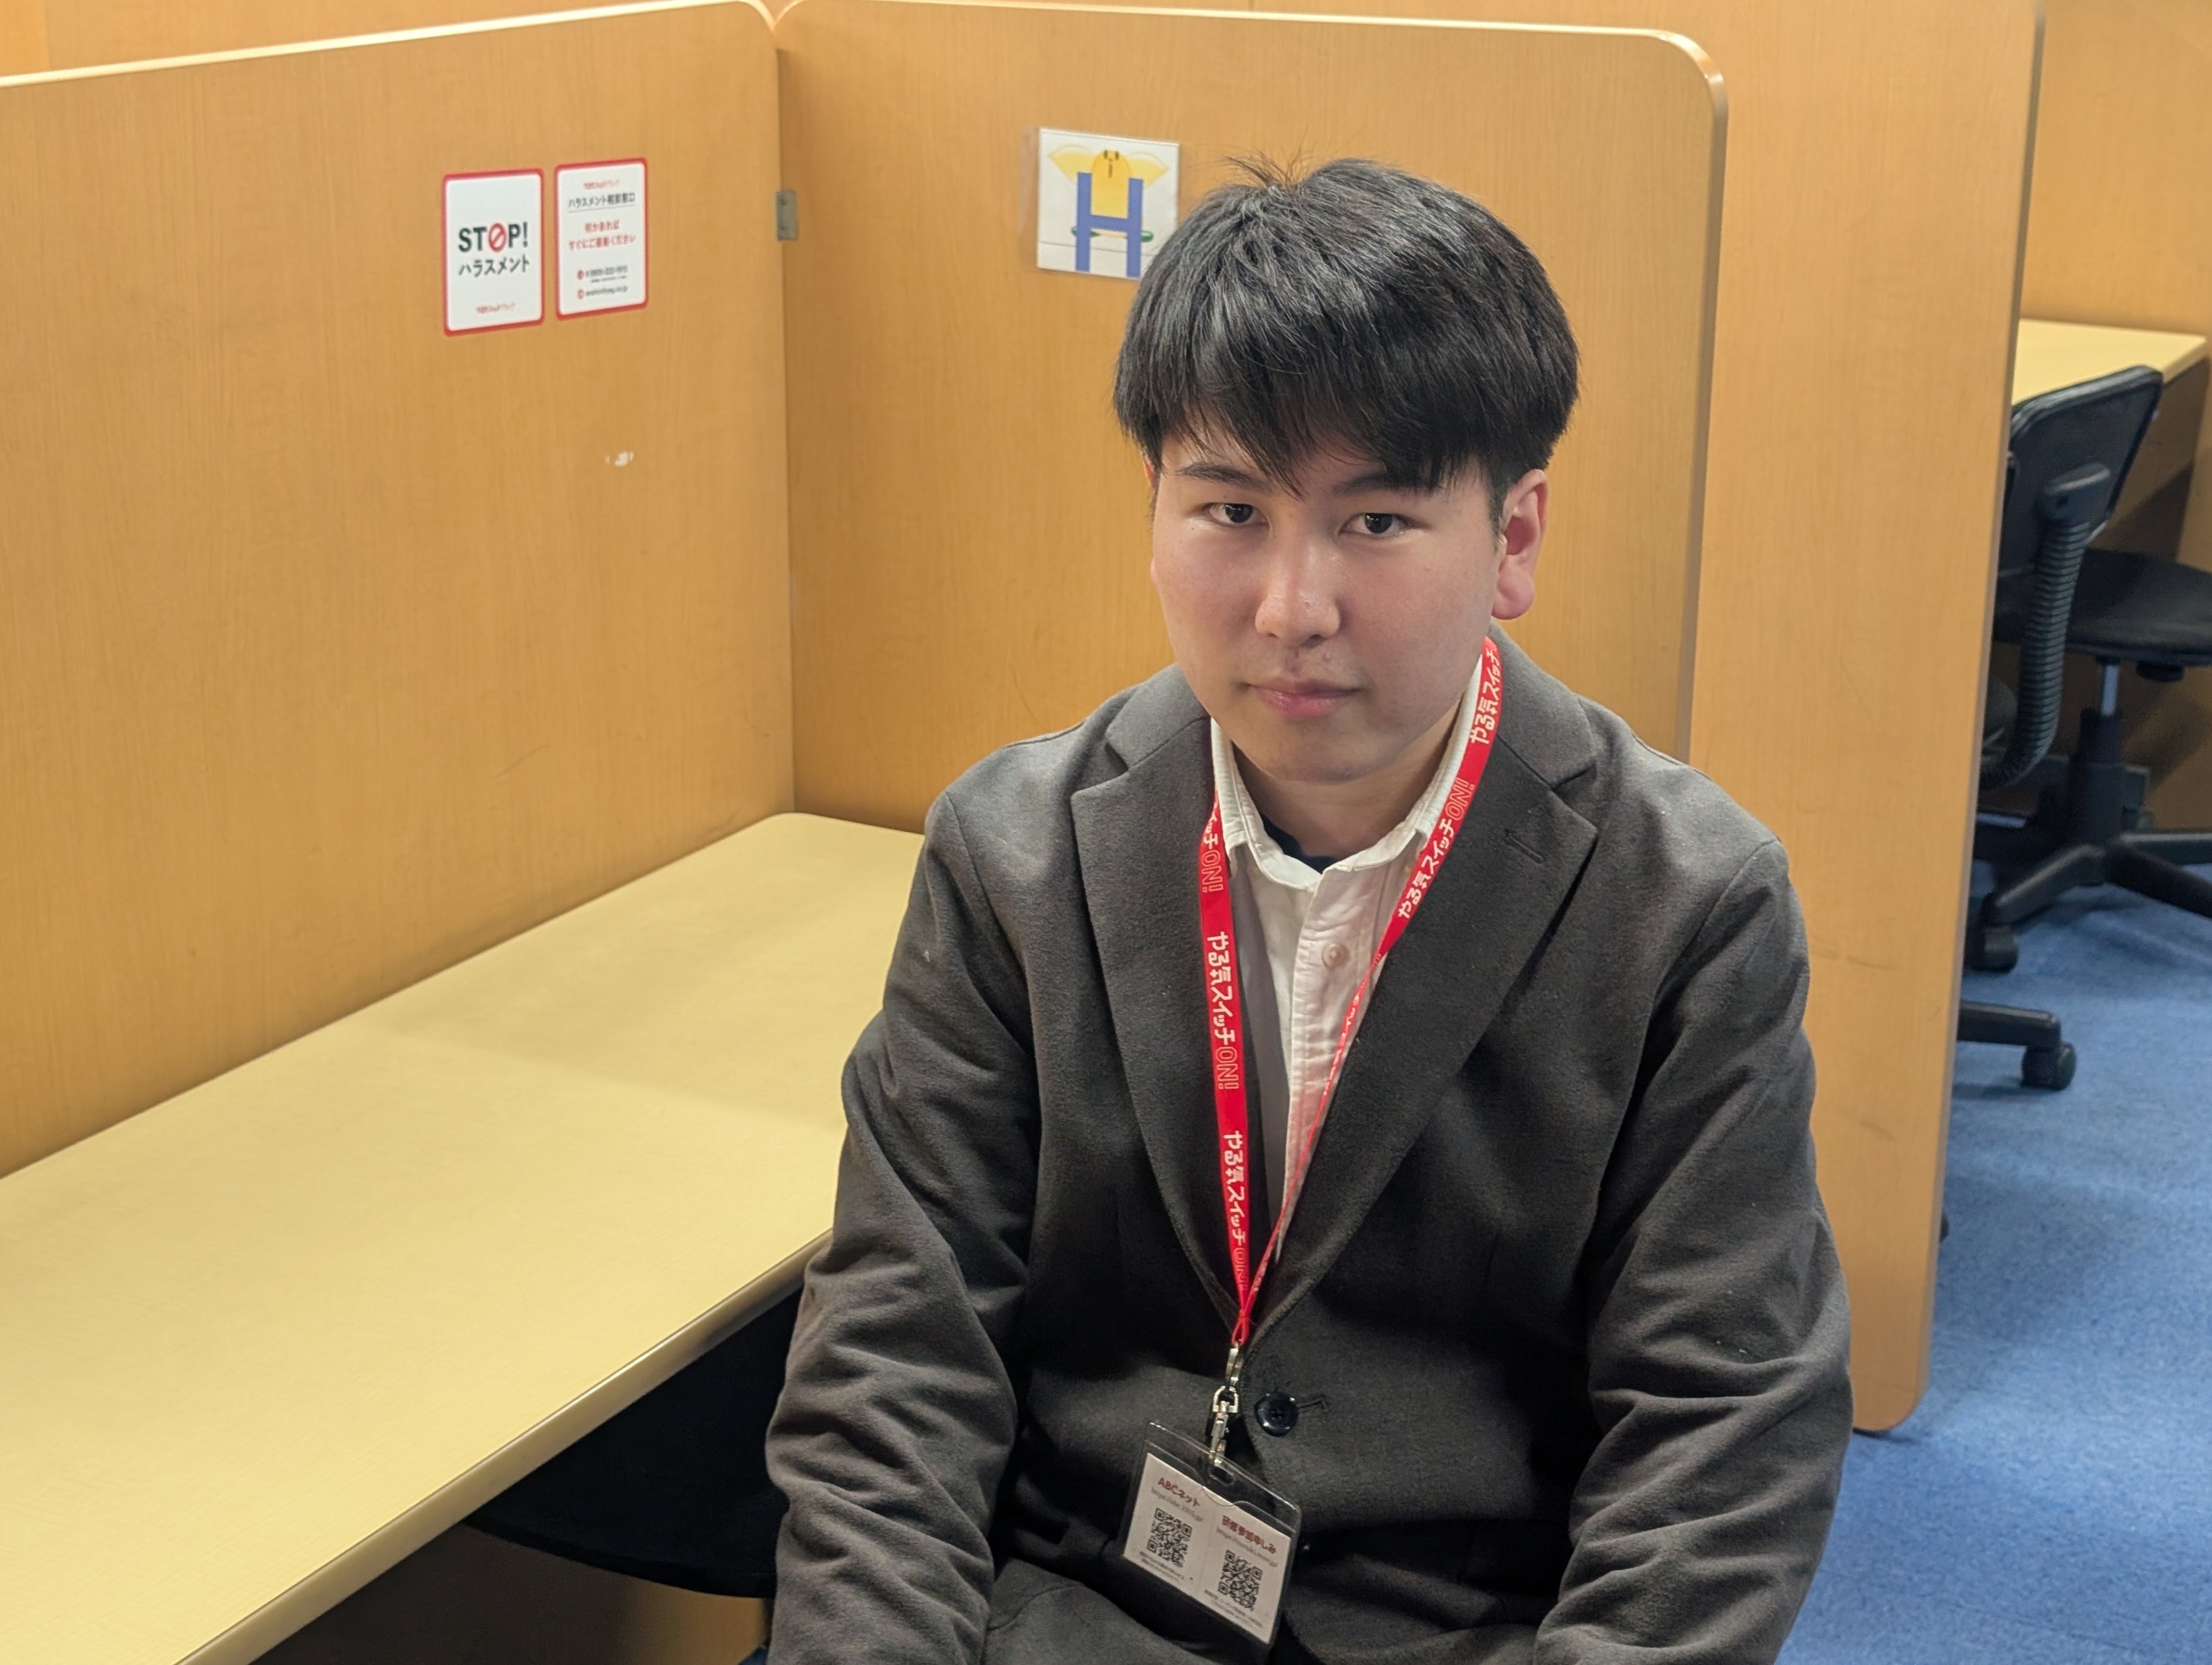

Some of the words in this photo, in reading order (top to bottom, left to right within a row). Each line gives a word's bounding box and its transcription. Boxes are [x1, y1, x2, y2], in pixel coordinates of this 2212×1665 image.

[457, 222, 528, 254] STOP!
[458, 254, 530, 278] ハラスメント
[1470, 644, 1501, 745] やる気スイッチ
[1398, 777, 1476, 919] やる気スイッチON!
[1207, 931, 1239, 1090] やる気スイッチON!
[1157, 1477, 1200, 1507] ABCネット
